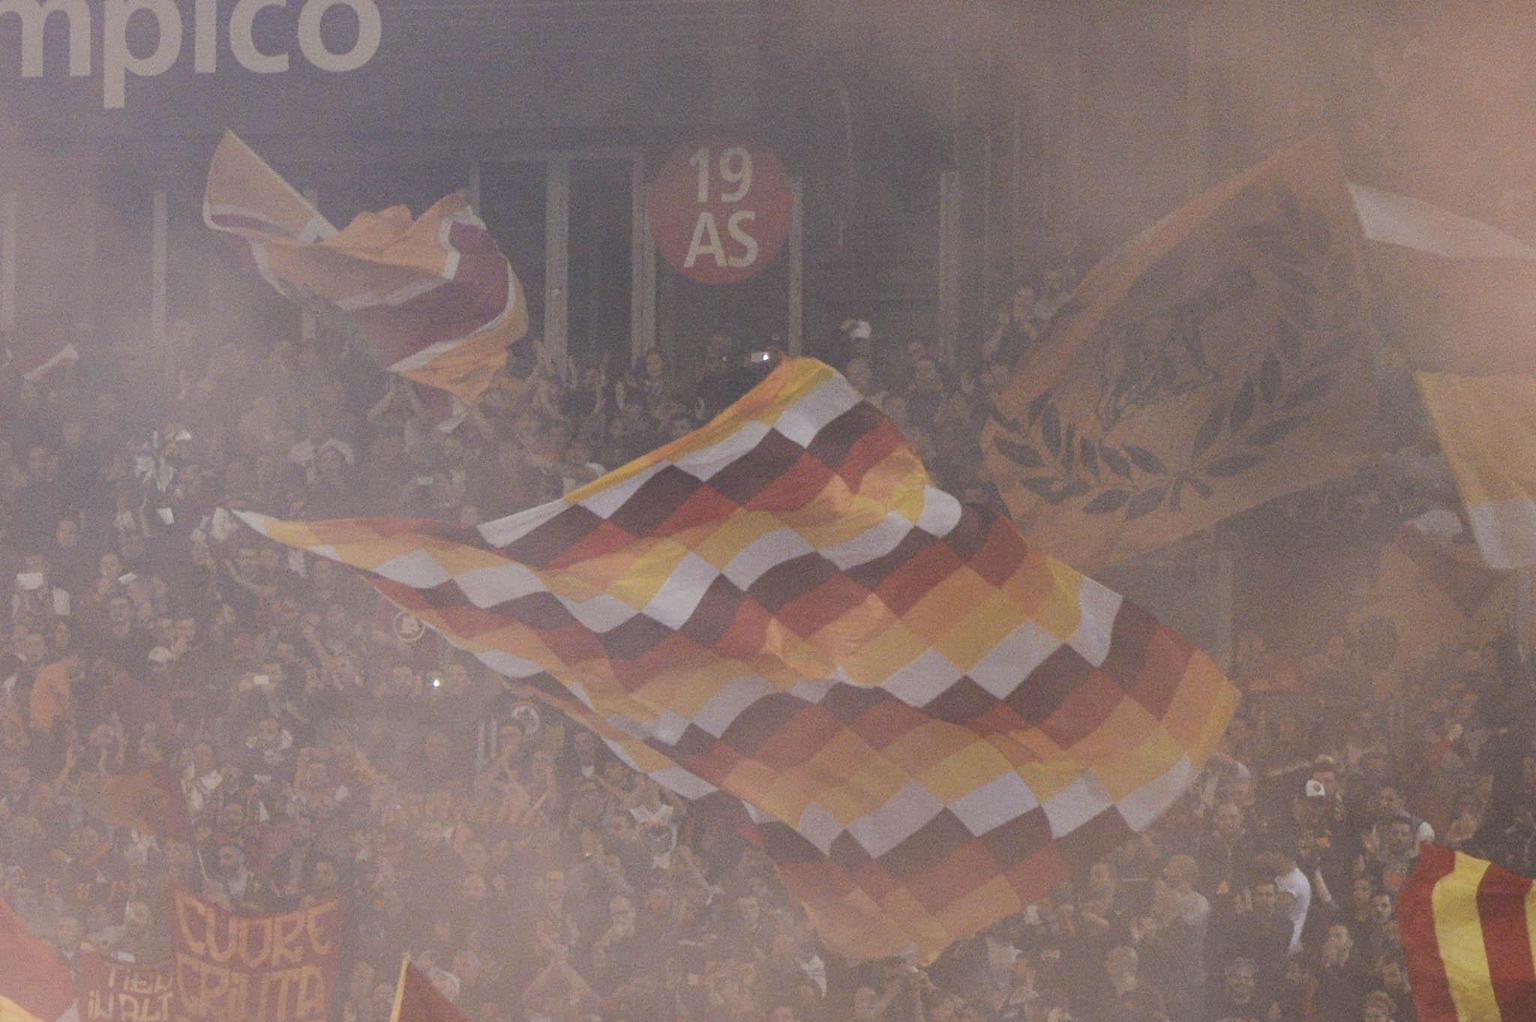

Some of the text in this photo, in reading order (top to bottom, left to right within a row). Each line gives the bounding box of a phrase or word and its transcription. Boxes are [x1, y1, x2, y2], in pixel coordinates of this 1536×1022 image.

[689, 146, 754, 203] 19
[683, 209, 759, 268] AS
[176, 890, 339, 968] CUORE
